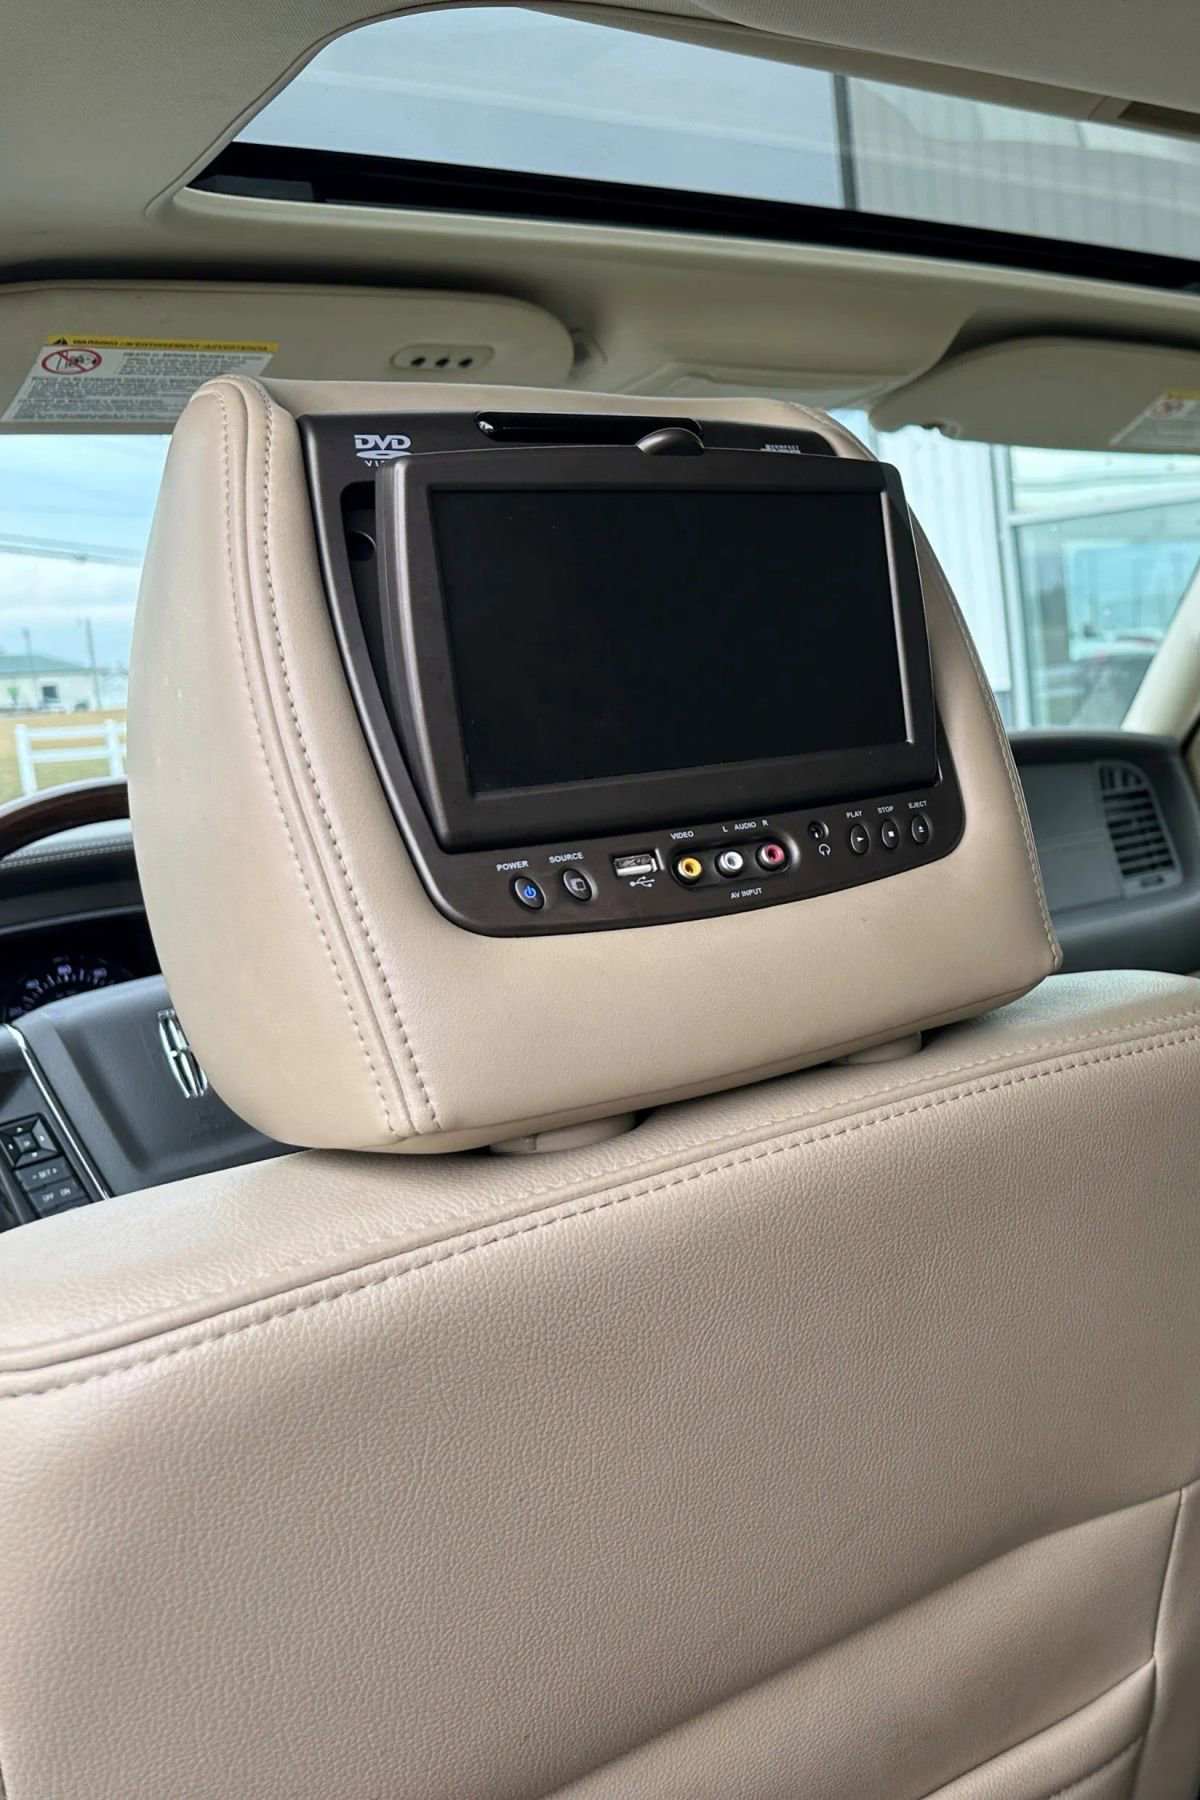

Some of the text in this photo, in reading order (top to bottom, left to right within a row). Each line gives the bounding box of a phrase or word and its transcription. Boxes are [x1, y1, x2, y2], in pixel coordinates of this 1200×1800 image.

[354, 434, 412, 451] DVD
[877, 805, 894, 814] STOP
[908, 800, 928, 809] EJECT
[846, 810, 863, 819] PLAY
[722, 819, 769, 833] L AUDIO R
[670, 830, 695, 840] VIDEO
[548, 851, 585, 864] SOURCE
[496, 860, 529, 872] POWER
[730, 887, 763, 899] AV INPUT
